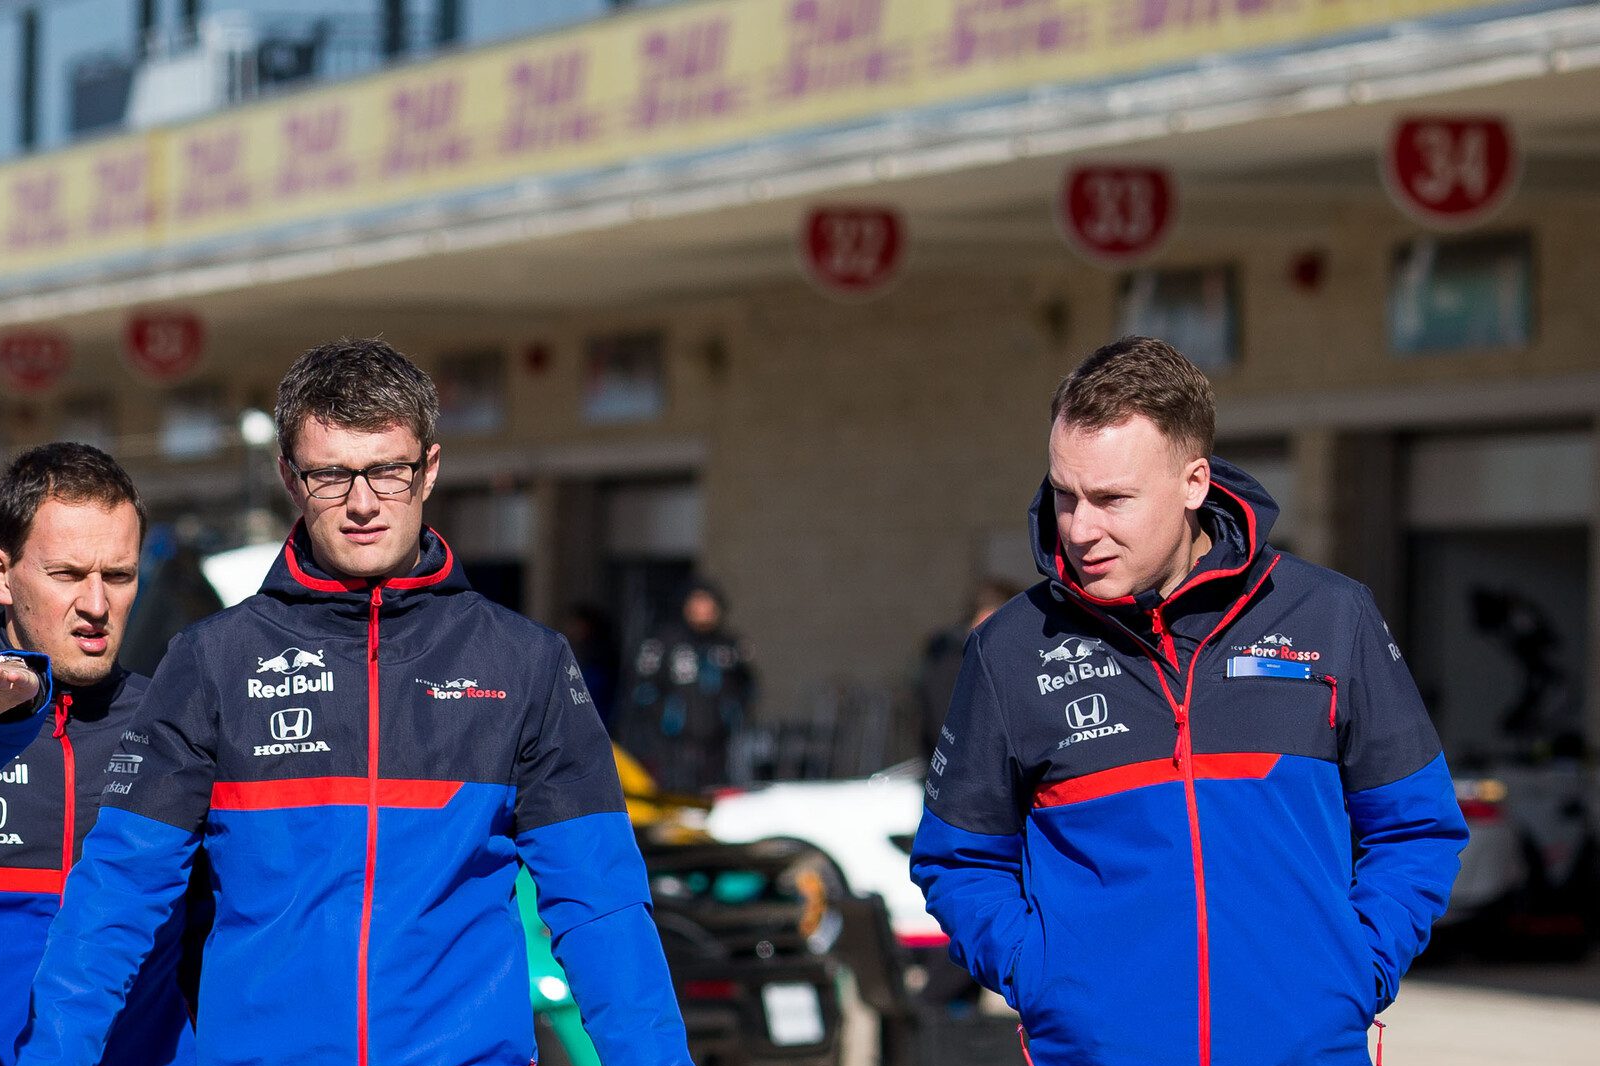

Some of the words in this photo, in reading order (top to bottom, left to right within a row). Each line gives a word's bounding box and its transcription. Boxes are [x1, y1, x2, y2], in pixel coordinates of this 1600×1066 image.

[1412, 125, 1487, 202] 34
[1247, 644, 1277, 658] Toro
[1279, 645, 1321, 662] Rosso
[247, 676, 291, 699] Red
[292, 671, 334, 694] Bull
[1036, 663, 1079, 695] Red
[1078, 655, 1122, 680] Bull
[431, 687, 463, 700] Toro
[466, 687, 507, 700] Rosso
[253, 740, 331, 756] HONDA
[1056, 722, 1130, 750] HONDA
